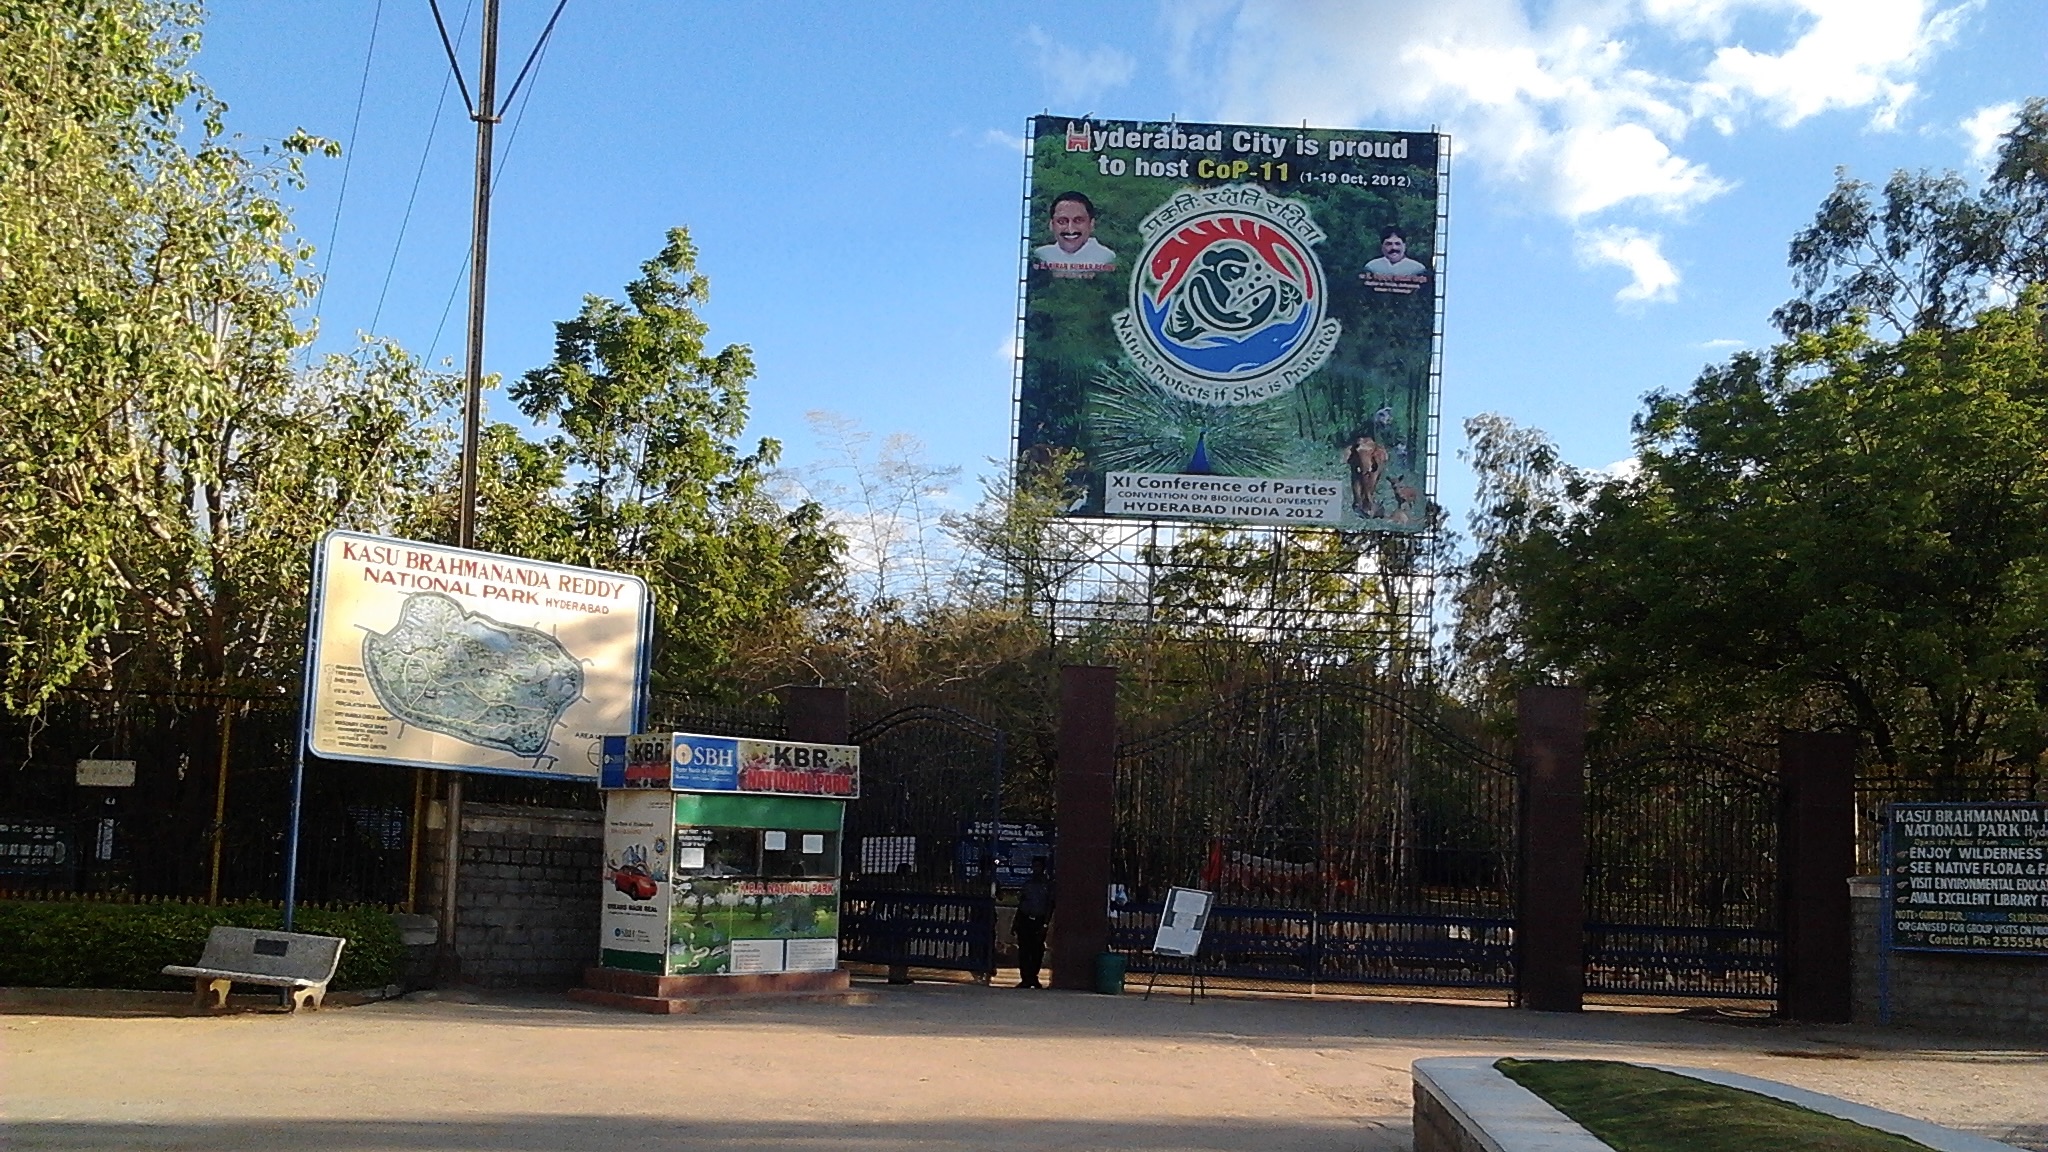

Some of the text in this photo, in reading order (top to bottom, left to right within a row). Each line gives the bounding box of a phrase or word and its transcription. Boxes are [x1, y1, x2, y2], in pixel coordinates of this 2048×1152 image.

[1232, 131, 1287, 158] City
[1296, 134, 1319, 156] is
[1329, 138, 1408, 161] proud
[1098, 154, 1411, 187] to host CoP-11 (1-19 Oct, 2012)
[1116, 313, 1337, 401] Nature Protects if She is Protected
[1112, 476, 1337, 496] XI Conference of Parties
[1118, 491, 1329, 505] CONVENTION ON BIOLOGICAL DIVERSITY
[1124, 501, 1324, 519] HYDERABAD INDIA 2012
[343, 541, 625, 600] KASU BRAHMANANDA REDDY
[364, 566, 610, 615] NATIONAL PARK HYDERABAD
[694, 746, 733, 767] SBH
[774, 746, 829, 768] KBR
[746, 769, 850, 794] NATIONAL PARK
[1896, 809, 1931, 823] KASU
[1935, 809, 2039, 823] BRAHMANANDA
[1904, 823, 1973, 837] NATIONAL
[1978, 823, 2021, 837] PARK
[1909, 847, 2043, 860] ENJOY WILDERNESS
[1910, 861, 1932, 874] SEE
[1935, 862, 1980, 874] NATIVE
[1983, 862, 2024, 875] FLORA
[2025, 863, 2036, 875] &
[767, 883, 811, 895] NATIONAL
[812, 883, 834, 895] PARK
[1909, 877, 1933, 889] VISIT
[1935, 877, 2015, 891] ENVIRONMENTAL
[1909, 891, 1938, 904] AVAIL
[1938, 892, 1992, 906] EXCELLENT
[1994, 894, 2039, 907] LIBRARY
[1897, 921, 1948, 933] ORGANISED
[1949, 922, 1966, 933] FOR
[1966, 923, 1993, 934] GROUP
[2019, 925, 2032, 936] ON
[1928, 933, 1969, 946] Contact
